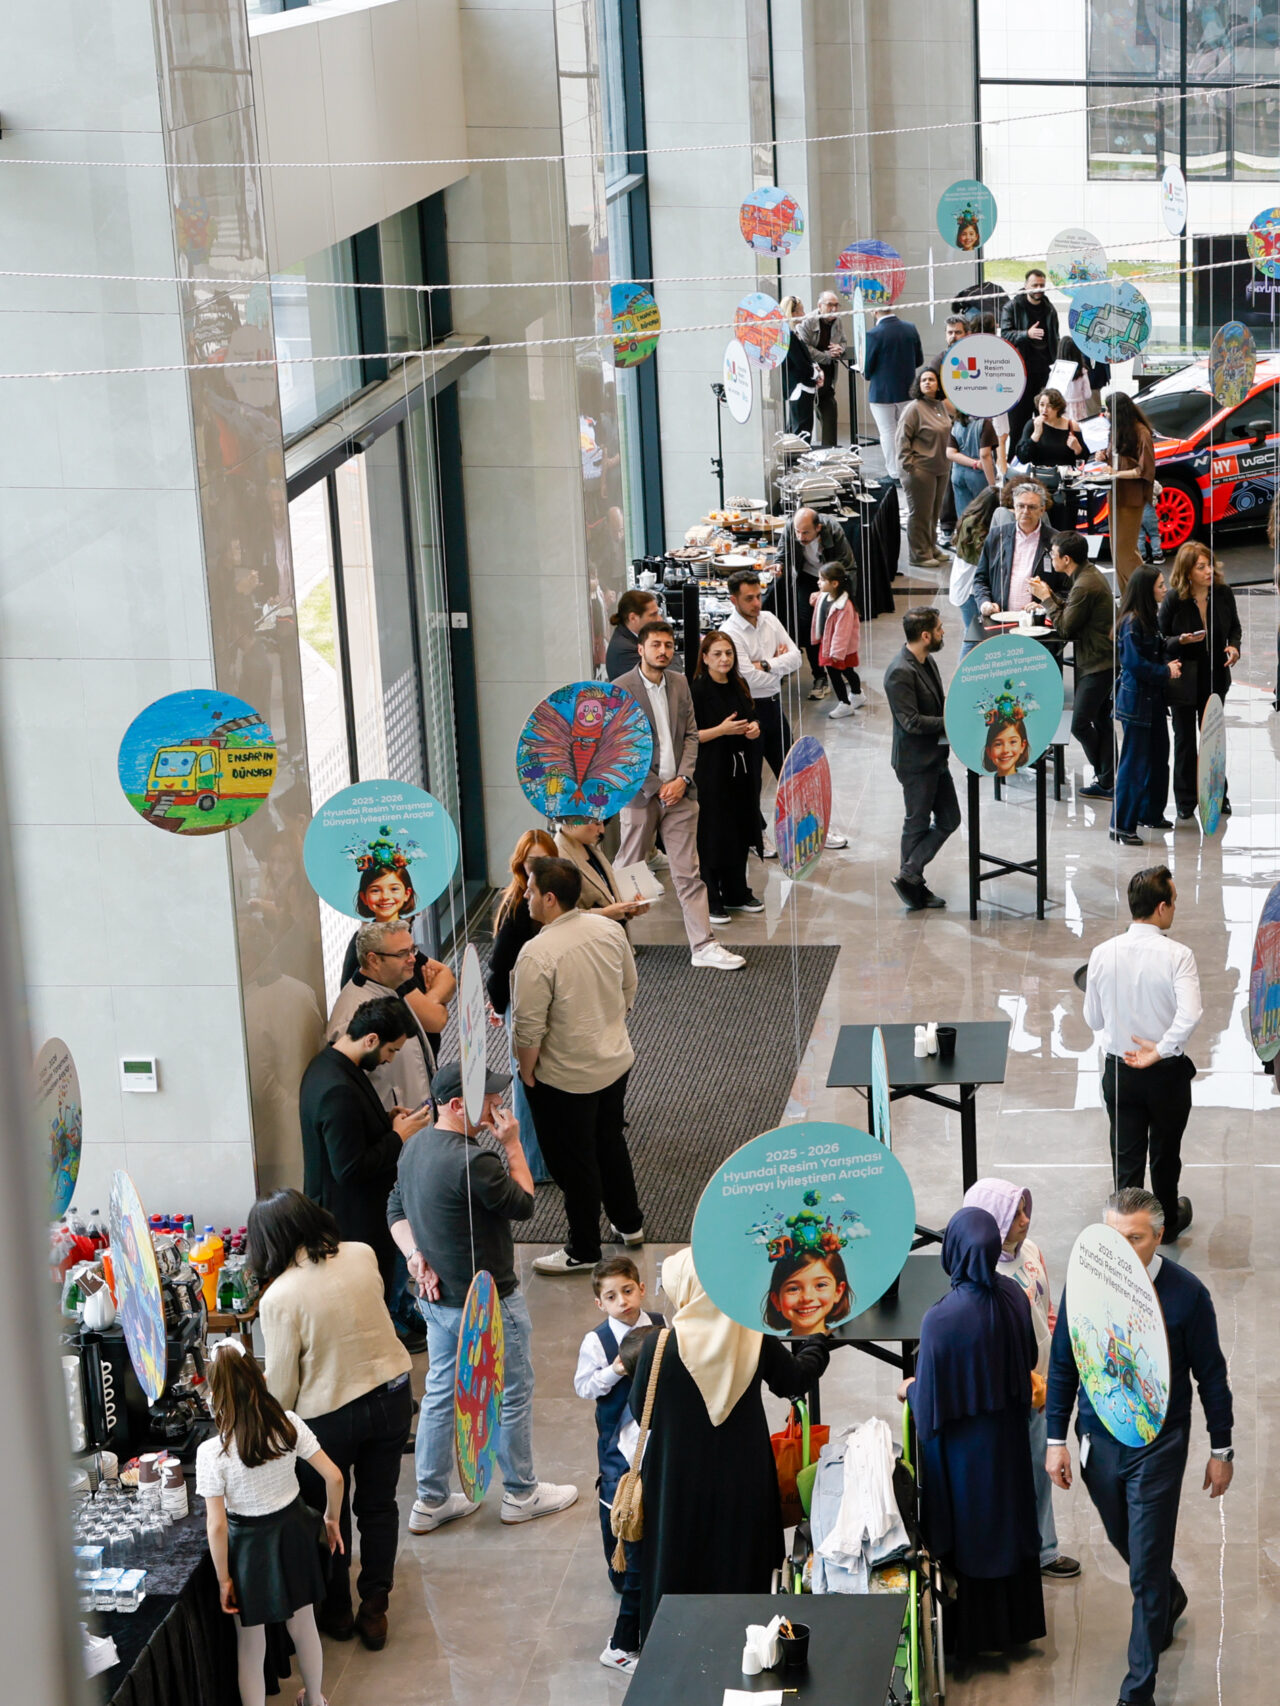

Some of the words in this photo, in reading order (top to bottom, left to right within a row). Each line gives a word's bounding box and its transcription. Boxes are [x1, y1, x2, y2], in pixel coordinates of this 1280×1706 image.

[1213, 459, 1231, 475] HY
[1241, 453, 1276, 467] WRC
[323, 807, 361, 818] Hyundai
[361, 805, 389, 814] Resim
[390, 801, 433, 812] Yarışması
[352, 796, 374, 806] 2025
[381, 794, 403, 803] 2026
[322, 817, 359, 827] Dünyayı
[403, 810, 435, 821] Araçlar
[765, 1148, 797, 1162] 2025
[807, 1142, 840, 1157] 2026
[722, 1181, 774, 1196] Dünyayı
[776, 1172, 836, 1189] İyileştiren
[838, 1165, 885, 1180] Araçlar
[723, 1165, 777, 1183] Hyundai
[779, 1160, 818, 1174] Resim
[820, 1152, 882, 1168] Yarışması
[1079, 1242, 1104, 1266] Hyundai
[1104, 1260, 1123, 1281] Resim
[1098, 1241, 1113, 1260] 2025
[1117, 1256, 1133, 1275] 2026
[1079, 1255, 1103, 1280] Dünyayı
[1131, 1294, 1154, 1317] Araçlar
